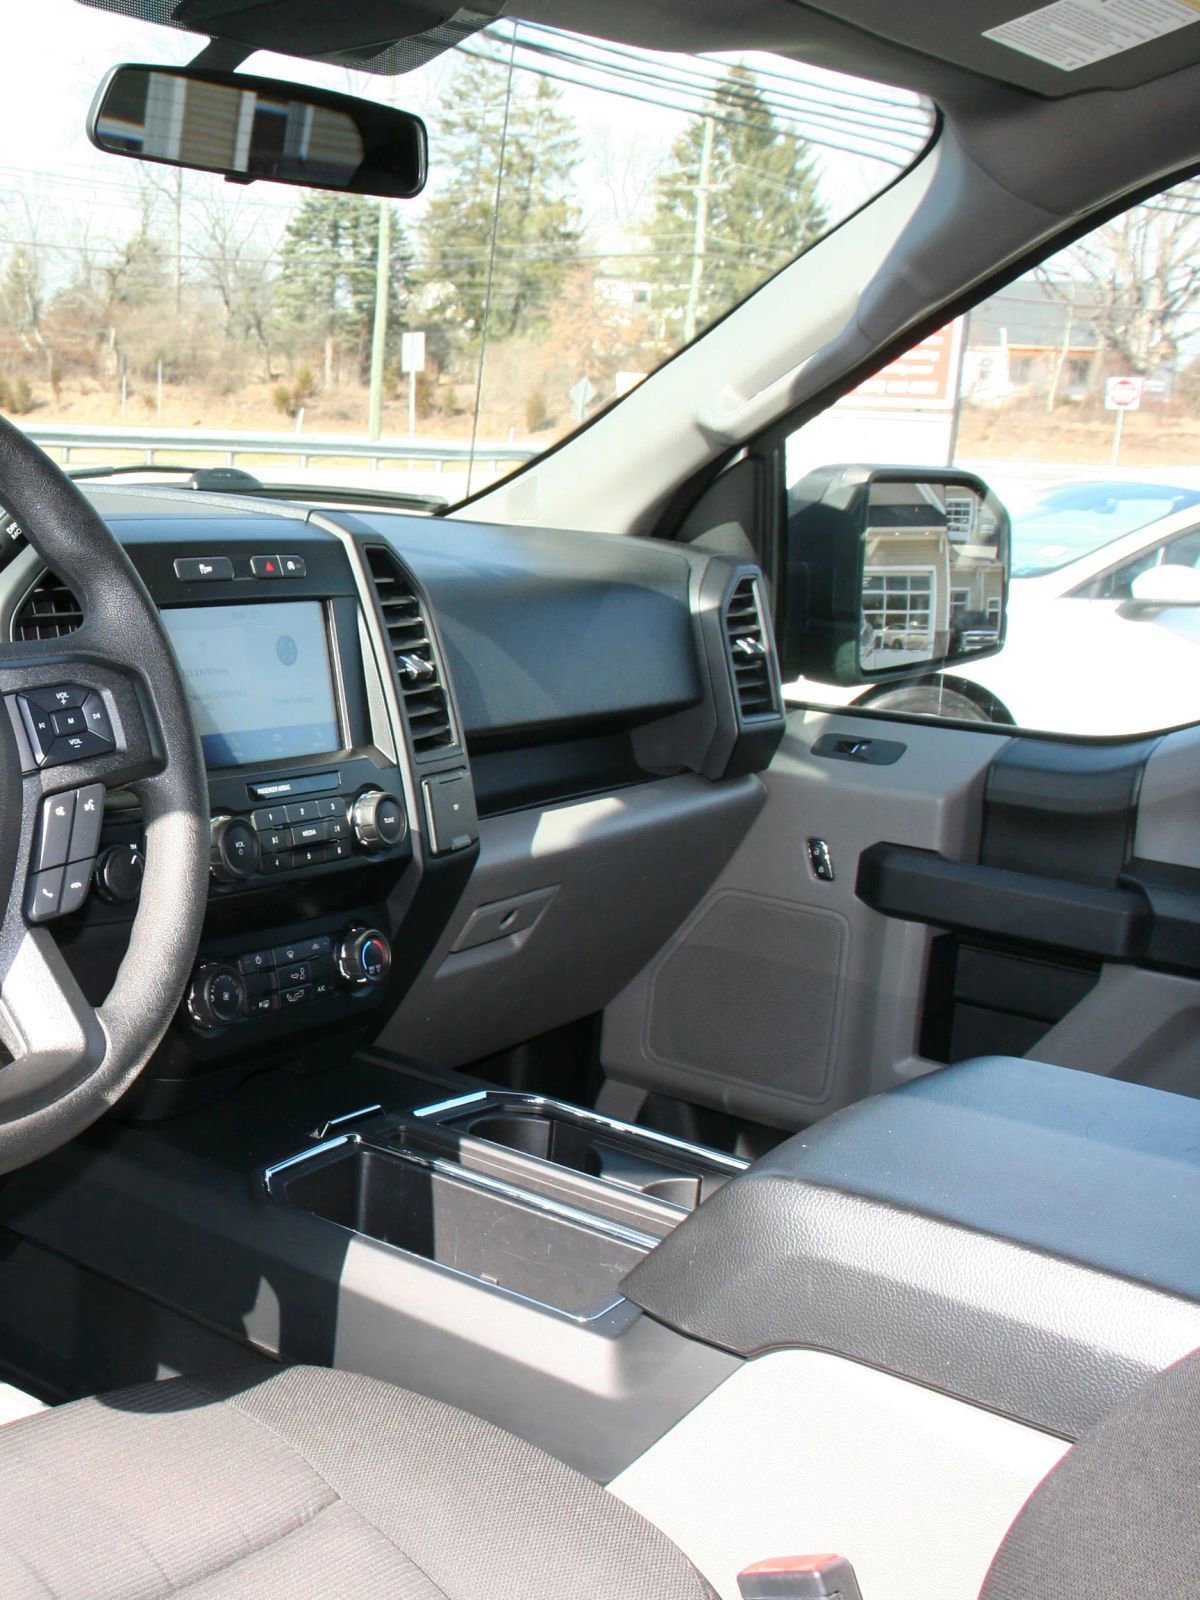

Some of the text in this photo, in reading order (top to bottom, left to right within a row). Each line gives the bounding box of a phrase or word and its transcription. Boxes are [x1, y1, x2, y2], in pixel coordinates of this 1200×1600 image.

[55, 691, 69, 699] VOL
[68, 738, 83, 746] VOL
[300, 808, 305, 816] 2
[268, 813, 273, 821] 1
[302, 828, 317, 837] MEDIA
